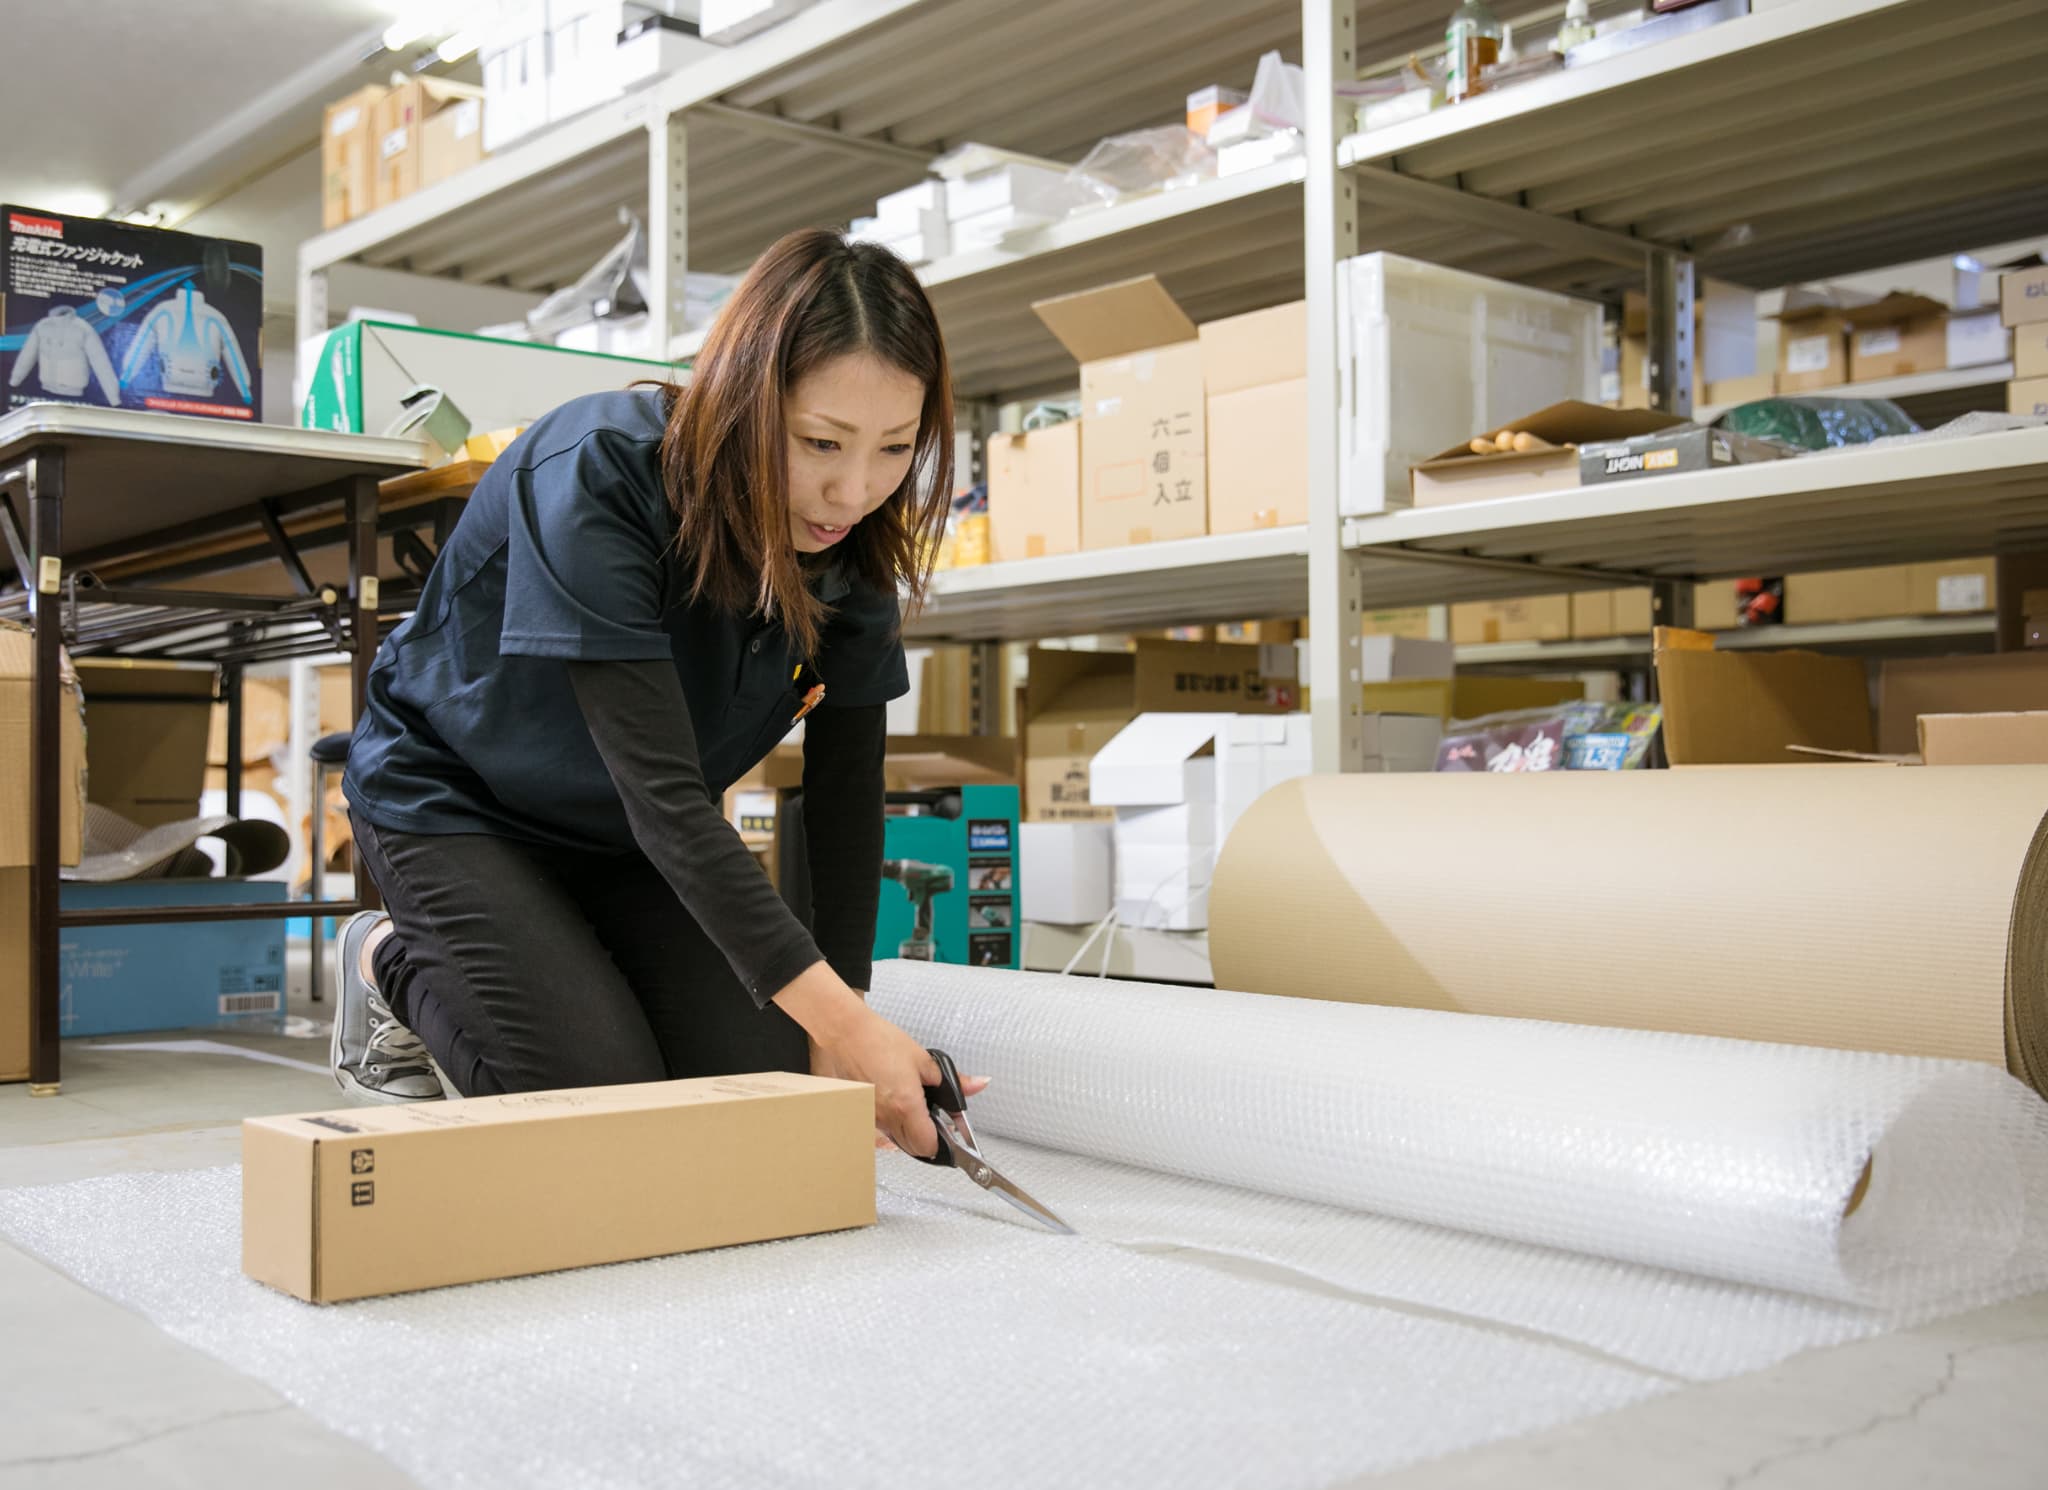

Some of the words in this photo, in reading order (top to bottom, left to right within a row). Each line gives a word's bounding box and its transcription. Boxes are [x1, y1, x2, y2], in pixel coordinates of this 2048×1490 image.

[1152, 417, 1171, 506] 六個入
[1606, 455, 1644, 474] NIGHT
